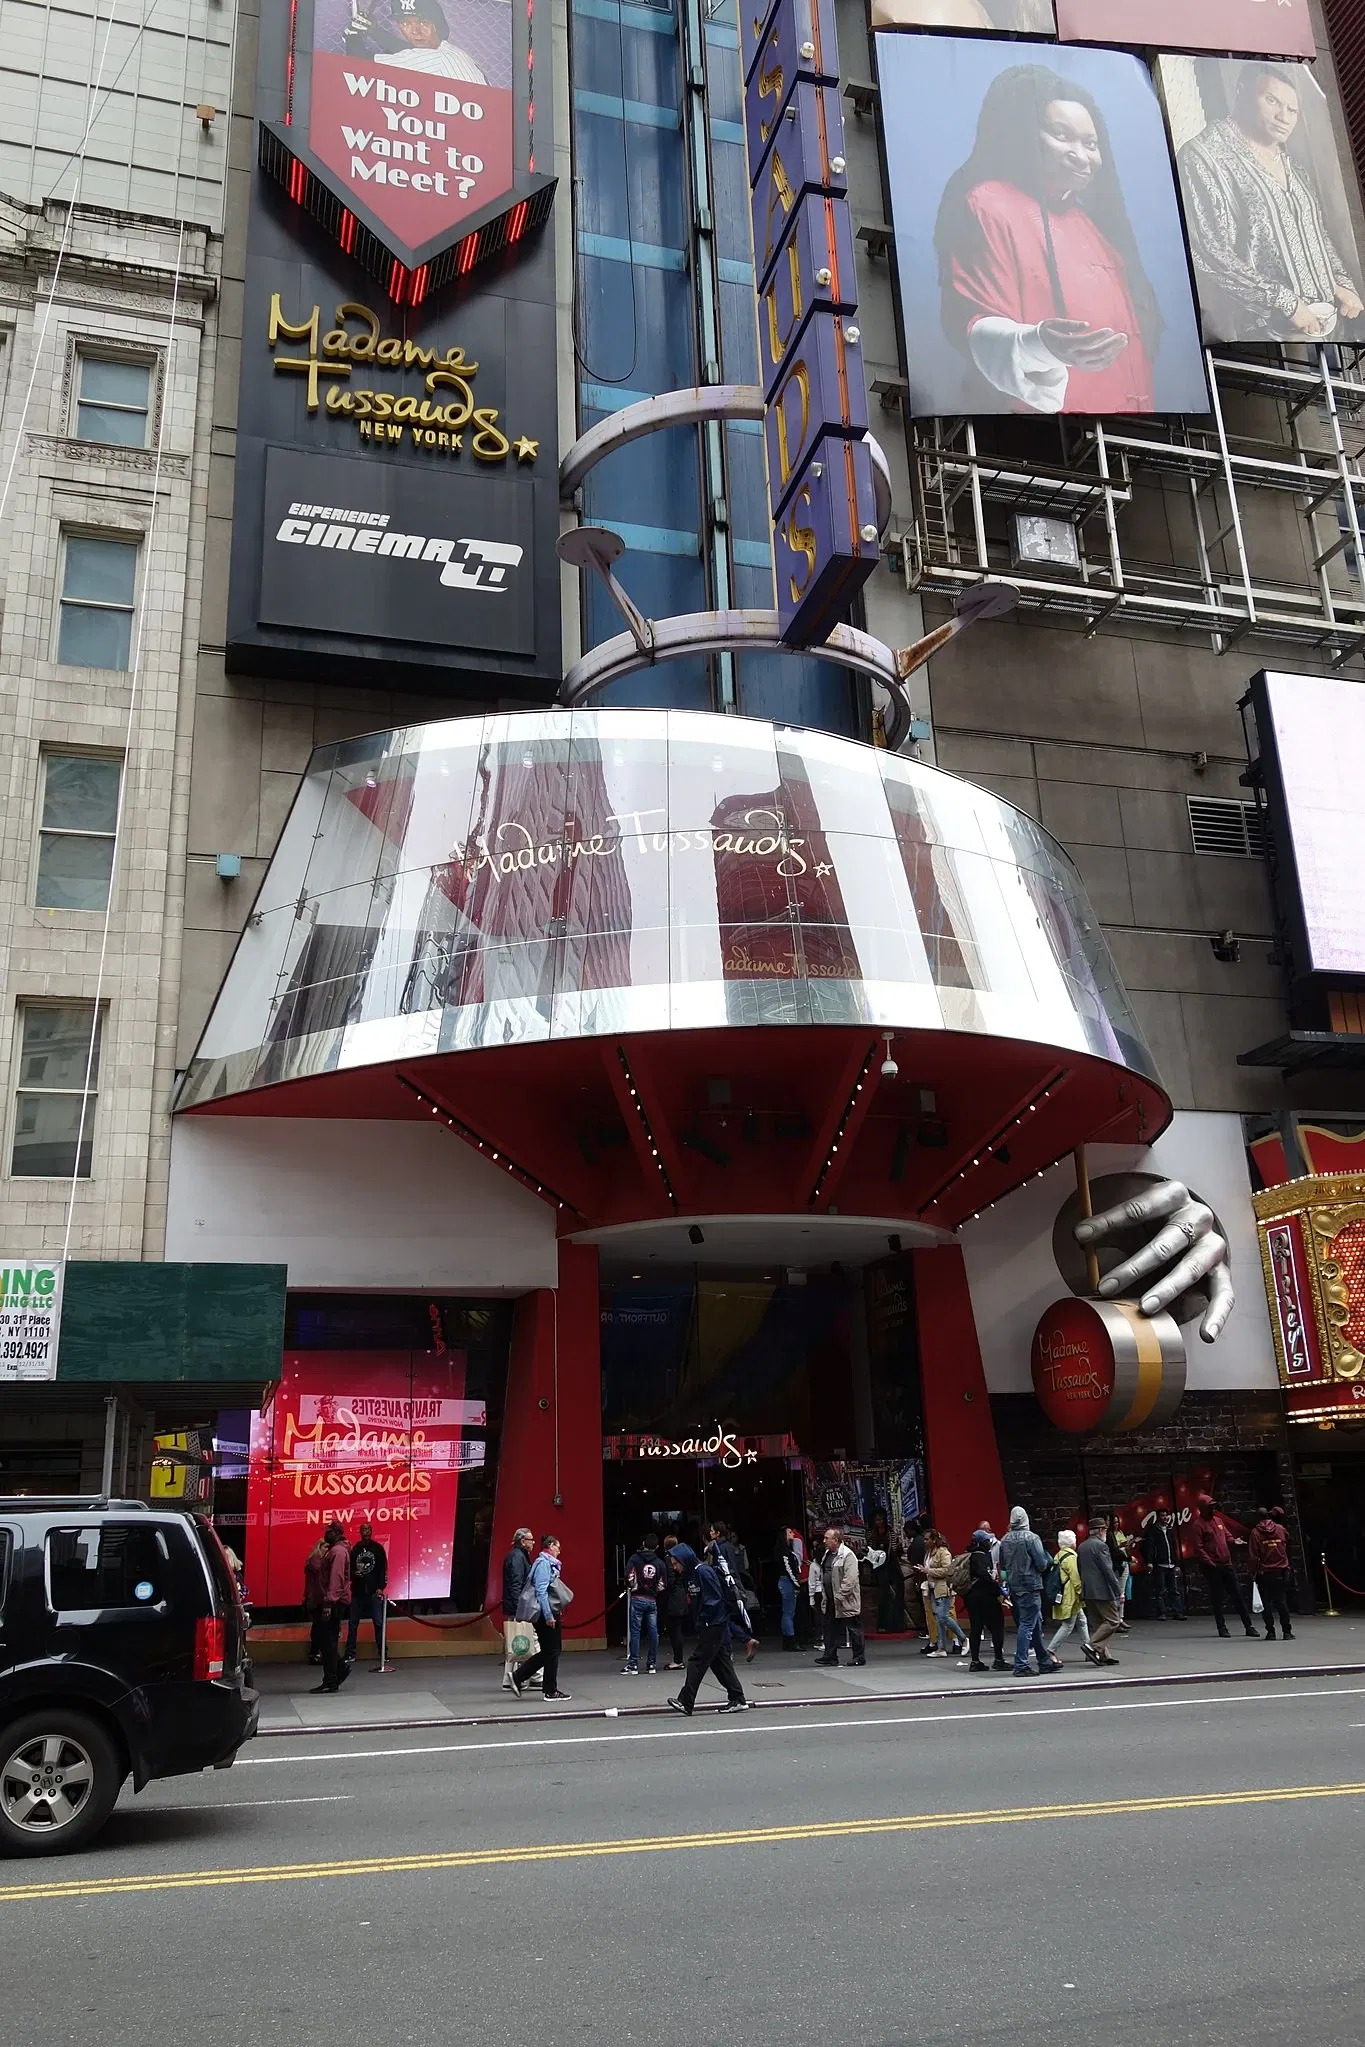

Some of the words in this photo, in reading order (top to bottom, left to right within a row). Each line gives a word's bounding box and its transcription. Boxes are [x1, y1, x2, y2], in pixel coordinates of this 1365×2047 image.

[343, 72, 420, 108] Who
[434, 91, 484, 121] Do
[381, 107, 446, 141] You
[340, 125, 431, 165] Want
[446, 148, 484, 174] to
[350, 155, 476, 200] Meet?
[268, 292, 479, 376] Madame
[273, 358, 510, 461] Tussauds
[360, 420, 403, 441] NEW
[413, 428, 464, 449] YORK
[288, 502, 391, 527] EXPERIENCE
[452, 821, 617, 883] Madame
[605, 808, 808, 877] Tussauds
[0, 1268, 56, 1296] ING
[32, 1296, 53, 1309] LLC
[8, 1326, 21, 1337] NY
[24, 1326, 50, 1338] 11101
[28, 1315, 51, 1326] Place
[0, 1341, 49, 1359] .392.4921
[1038, 1329, 1089, 1364] Madame
[1044, 1356, 1103, 1399] Tussauds
[283, 1408, 436, 1456] Madame
[276, 1453, 432, 1498] Tussauds
[825, 1491, 844, 1501] NEW
[825, 1498, 847, 1509] YORK
[307, 1509, 355, 1525] NEW
[364, 1506, 419, 1522] YORK
